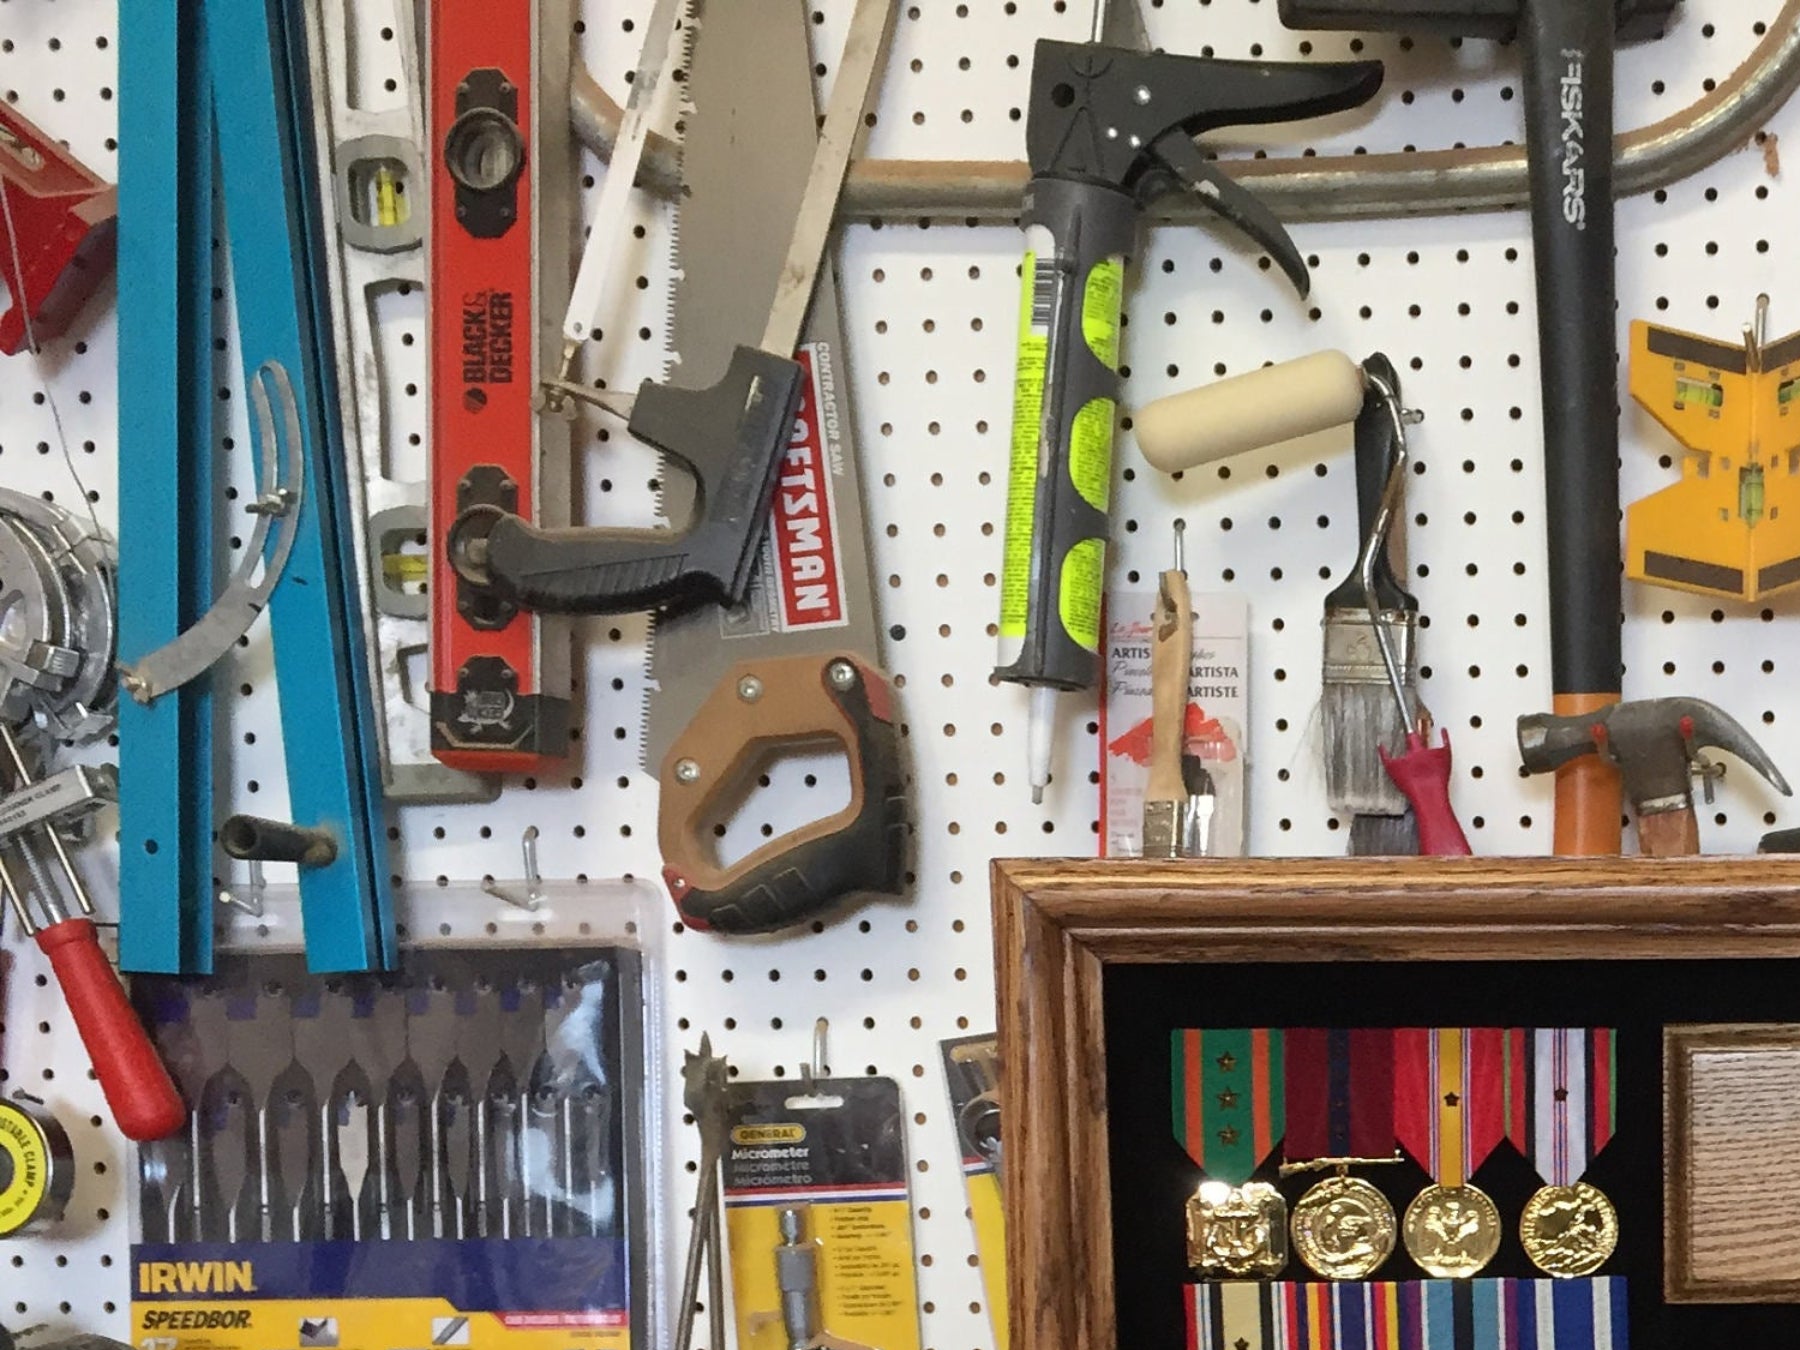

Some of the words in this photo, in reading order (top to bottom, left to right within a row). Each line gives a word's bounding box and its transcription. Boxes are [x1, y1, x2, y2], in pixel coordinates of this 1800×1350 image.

[1560, 62, 1585, 223] FISKARS
[488, 291, 513, 383] DECKER
[817, 341, 840, 440] CONTRACTOR
[829, 443, 845, 477] SAW
[1111, 647, 1151, 659] ARTIS
[739, 1128, 796, 1140] GENERAL
[731, 1146, 809, 1161] Micrometer
[138, 1260, 256, 1294] IRWIN
[141, 1309, 253, 1330] SPEEDBOR
